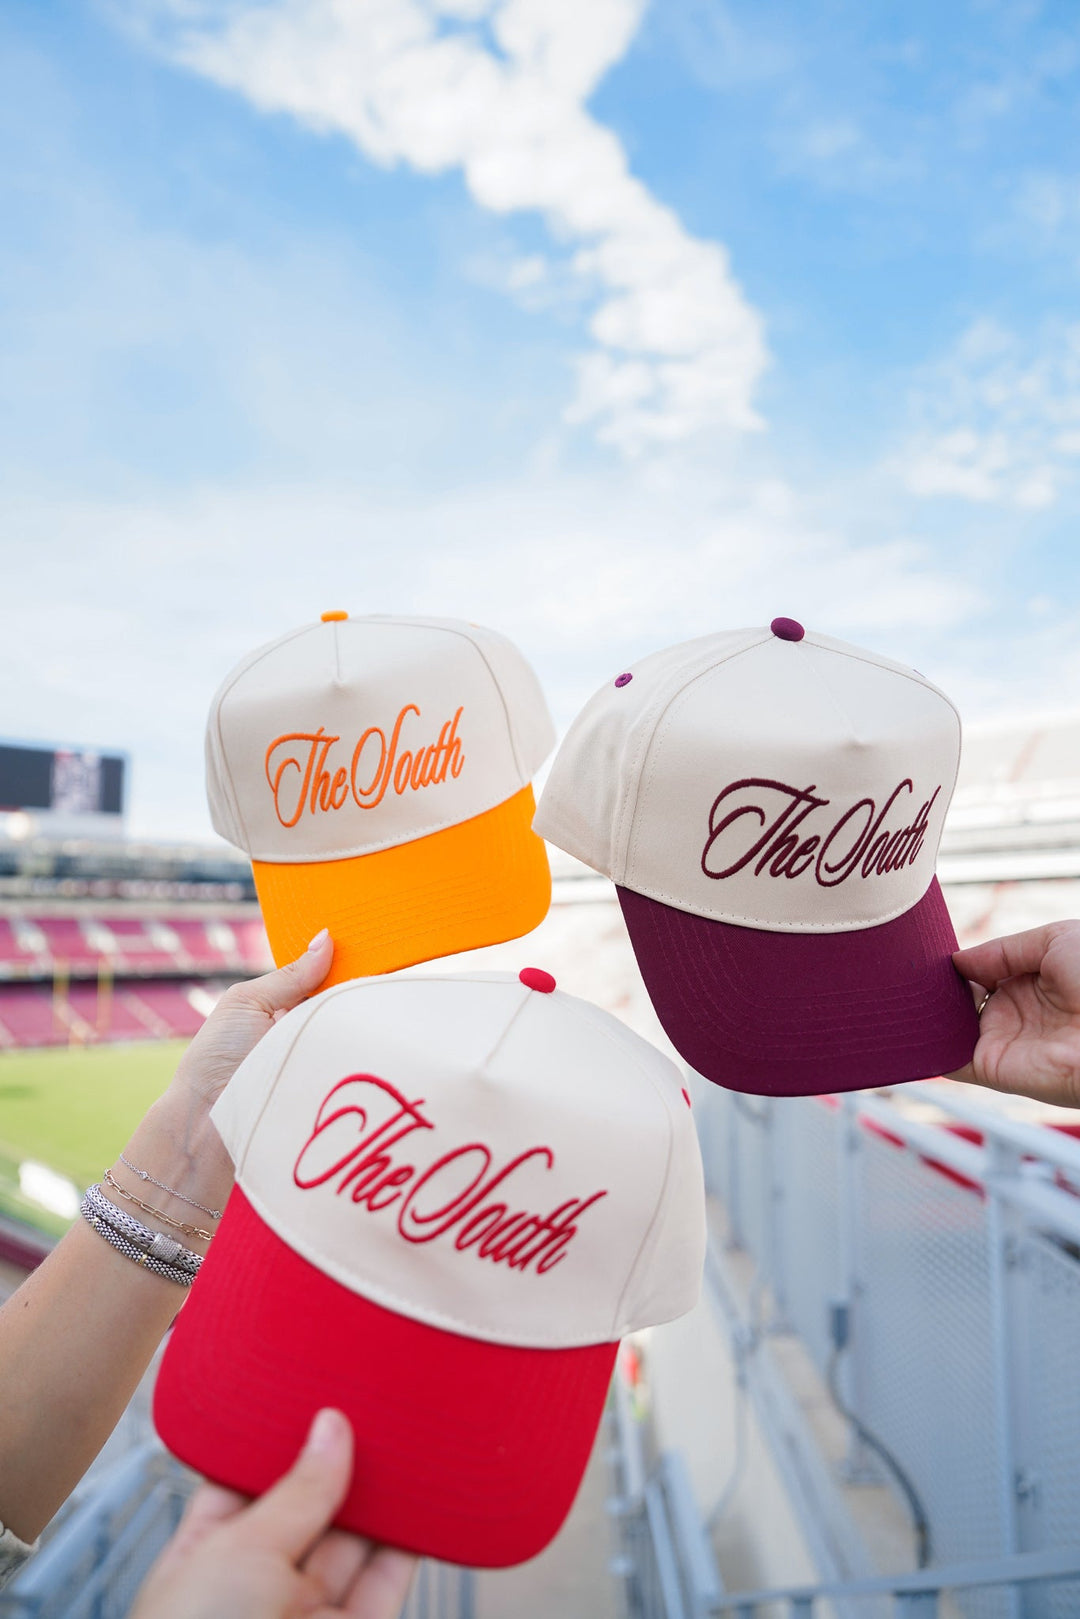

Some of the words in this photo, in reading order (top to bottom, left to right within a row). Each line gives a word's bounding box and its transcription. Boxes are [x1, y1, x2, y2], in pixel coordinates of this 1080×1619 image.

[265, 726, 350, 828] The
[351, 703, 465, 809] South
[701, 777, 830, 880] The
[815, 778, 942, 888] South
[293, 1073, 434, 1213] The
[397, 1142, 608, 1276] South
